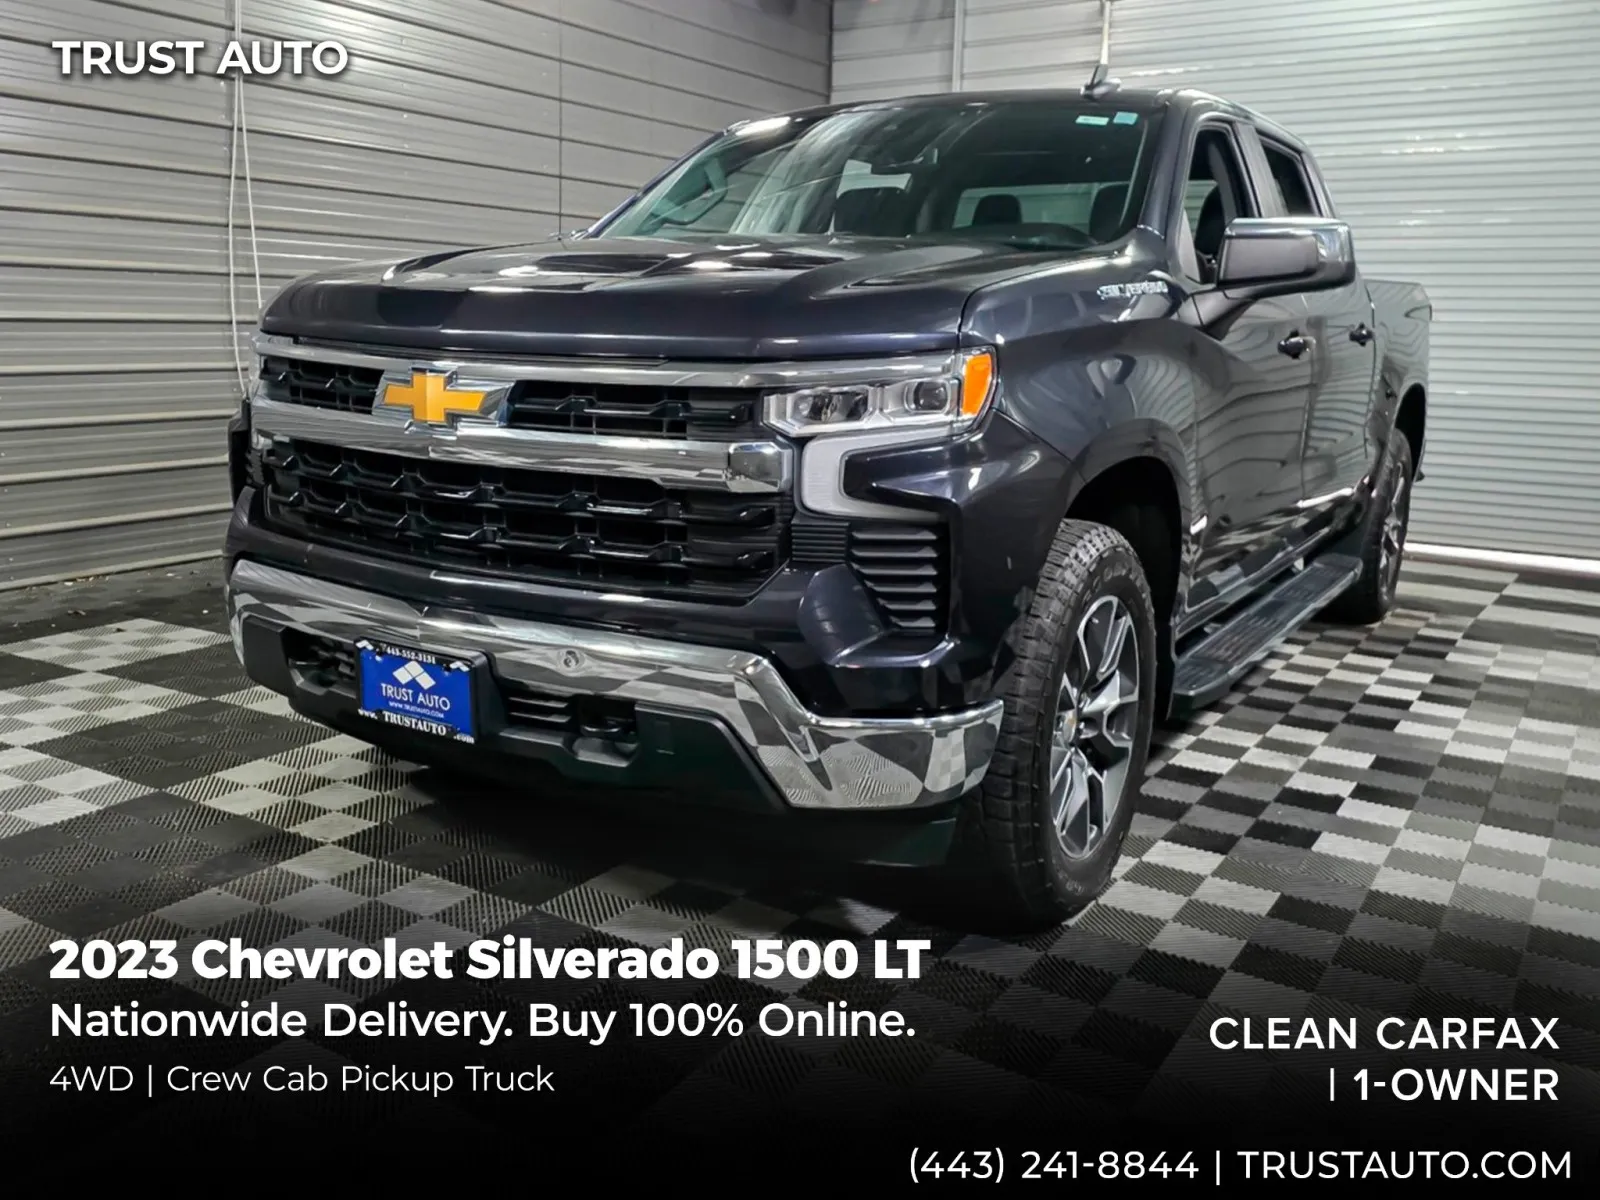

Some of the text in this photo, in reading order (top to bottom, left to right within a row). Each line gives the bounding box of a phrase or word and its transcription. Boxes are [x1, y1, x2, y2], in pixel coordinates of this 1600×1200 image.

[381, 683, 451, 711] TRUST AUTO
[382, 711, 447, 736] TRUSTAUTO
